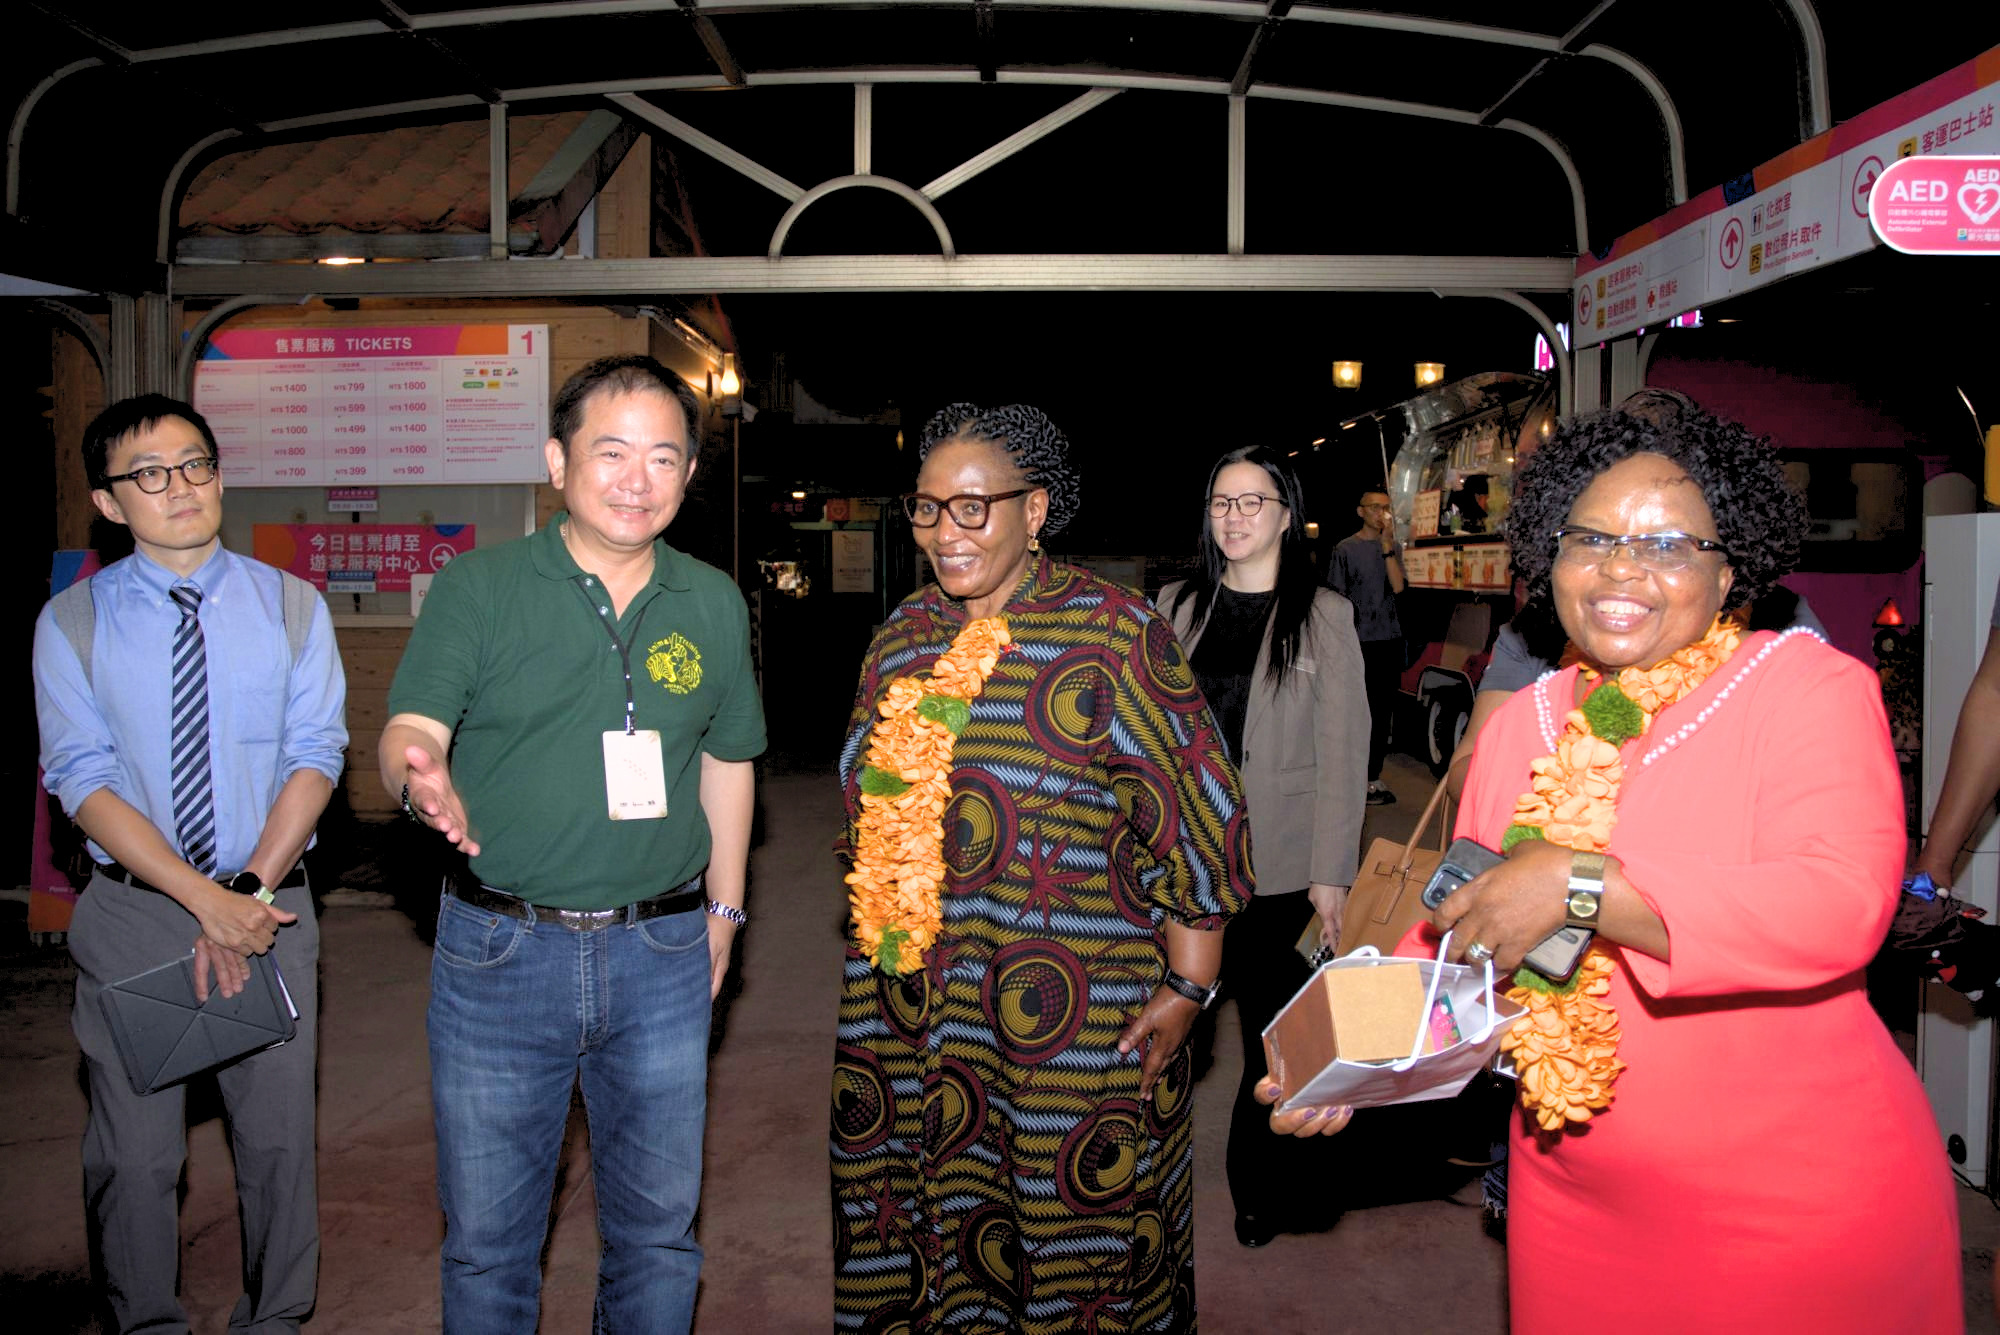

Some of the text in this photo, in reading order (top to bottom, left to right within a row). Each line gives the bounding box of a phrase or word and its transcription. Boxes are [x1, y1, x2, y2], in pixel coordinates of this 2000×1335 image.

[1921, 103, 1994, 153] 客運巴士站
[1964, 169, 2000, 183] AED
[1888, 180, 1949, 202] AED
[275, 337, 412, 353] 售票服務 TICKETS
[520, 330, 533, 355] 1
[284, 384, 307, 393] 1400
[348, 383, 365, 391] 799
[403, 381, 426, 390] 1800
[285, 405, 308, 413] 1200
[348, 404, 365, 412] 599
[403, 403, 426, 411] 1600
[286, 425, 308, 434] 1000
[348, 425, 366, 433] 499
[403, 424, 427, 432] 1400
[288, 447, 306, 456] 800
[348, 446, 366, 454] 399
[404, 445, 427, 454] 1000
[288, 468, 306, 476] 700
[349, 467, 366, 475] 399
[407, 466, 424, 474] 900
[310, 533, 421, 553] 今日售票請至
[310, 554, 421, 573] 遊客服務中心
[648, 636, 701, 660] Animal Training
